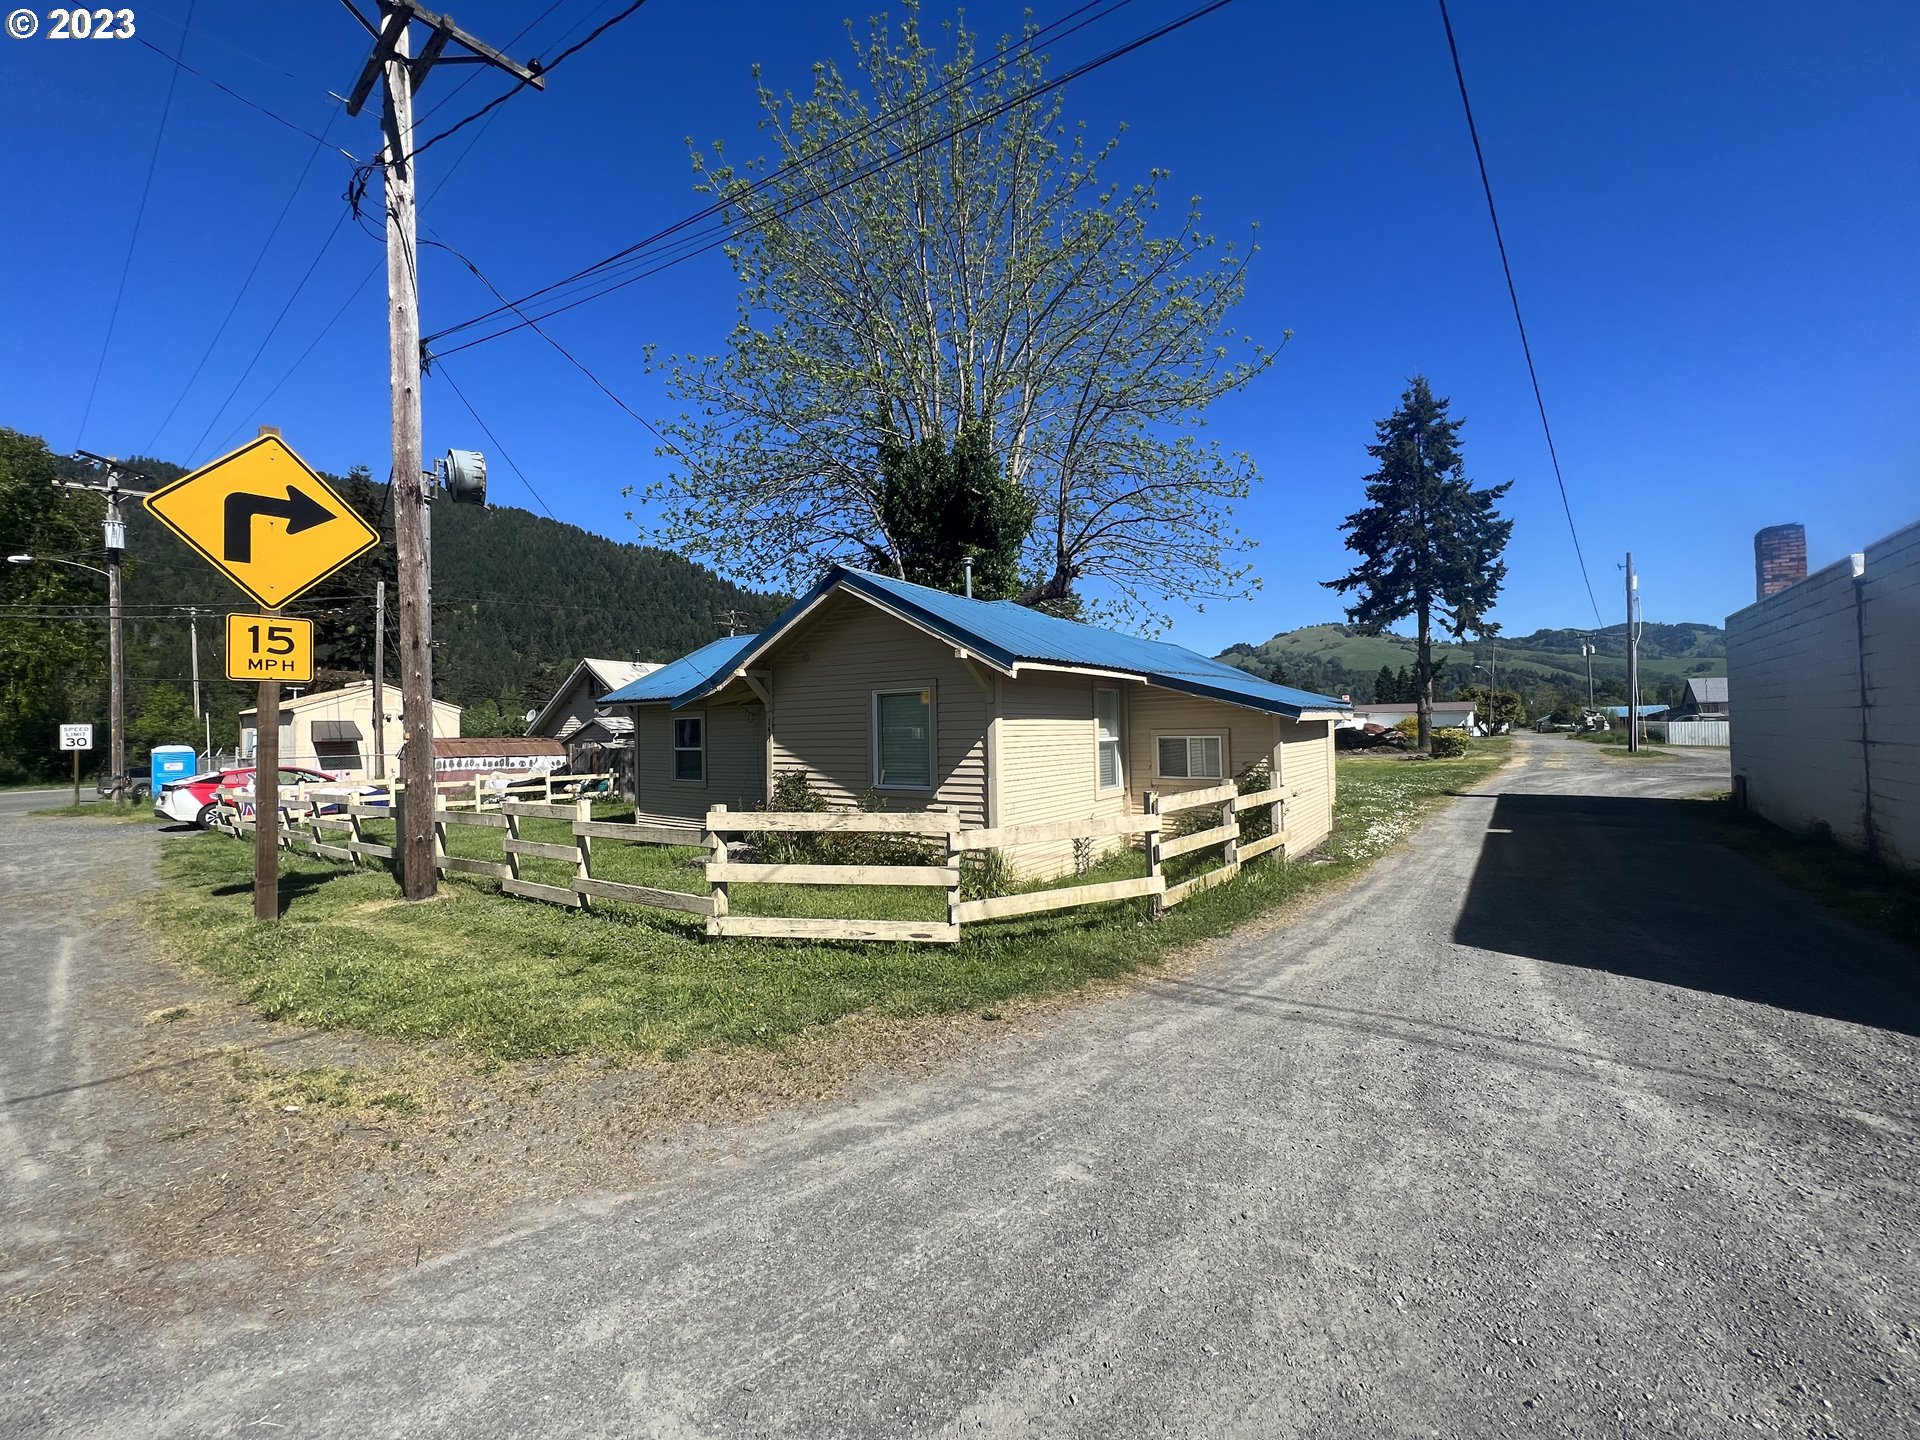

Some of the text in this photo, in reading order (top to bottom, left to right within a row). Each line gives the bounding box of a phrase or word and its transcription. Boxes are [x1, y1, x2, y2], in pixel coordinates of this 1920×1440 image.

[248, 625, 295, 655] 15
[248, 658, 295, 672] MPH
[65, 737, 88, 747] 30
